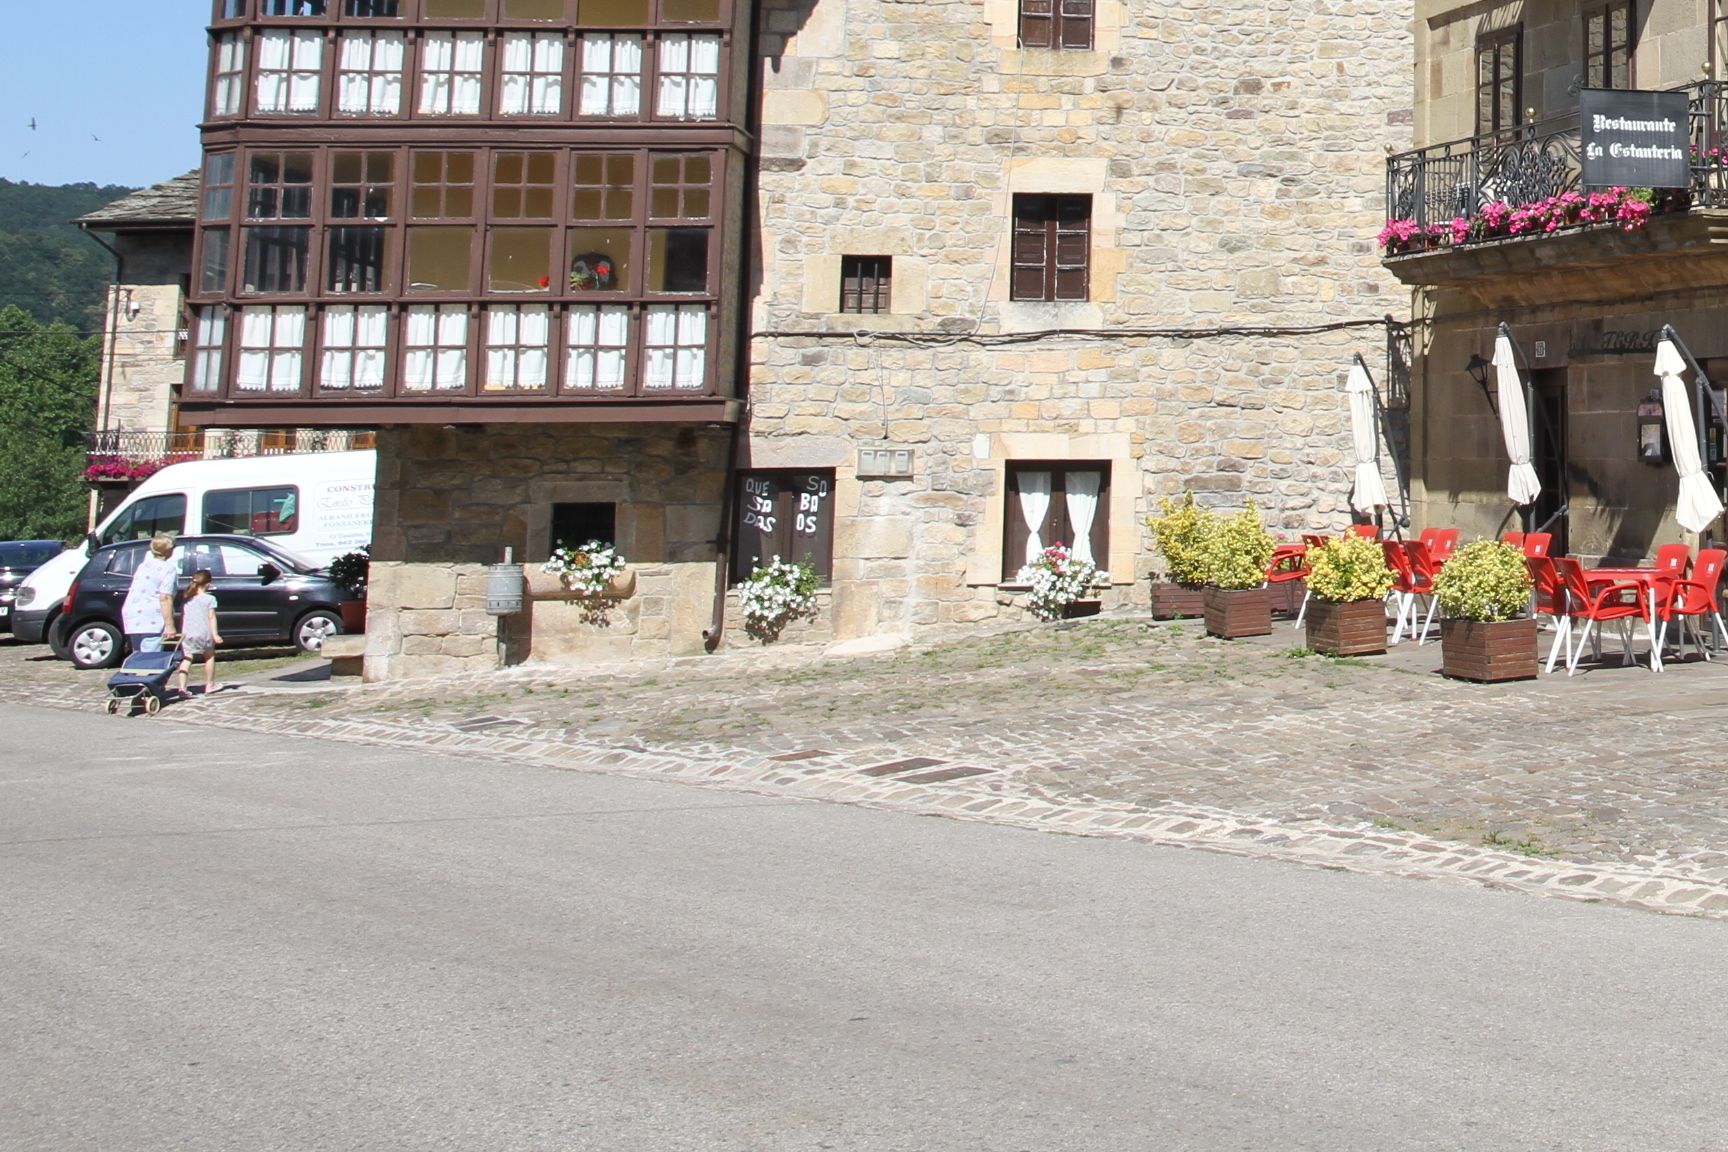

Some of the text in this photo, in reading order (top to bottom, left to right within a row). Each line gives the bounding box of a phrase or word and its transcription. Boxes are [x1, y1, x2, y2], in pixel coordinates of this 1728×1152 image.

[1592, 114, 1676, 133] Restaurante
[1586, 142, 1603, 160] La
[800, 493, 818, 512] BA
[796, 513, 817, 533] OS
